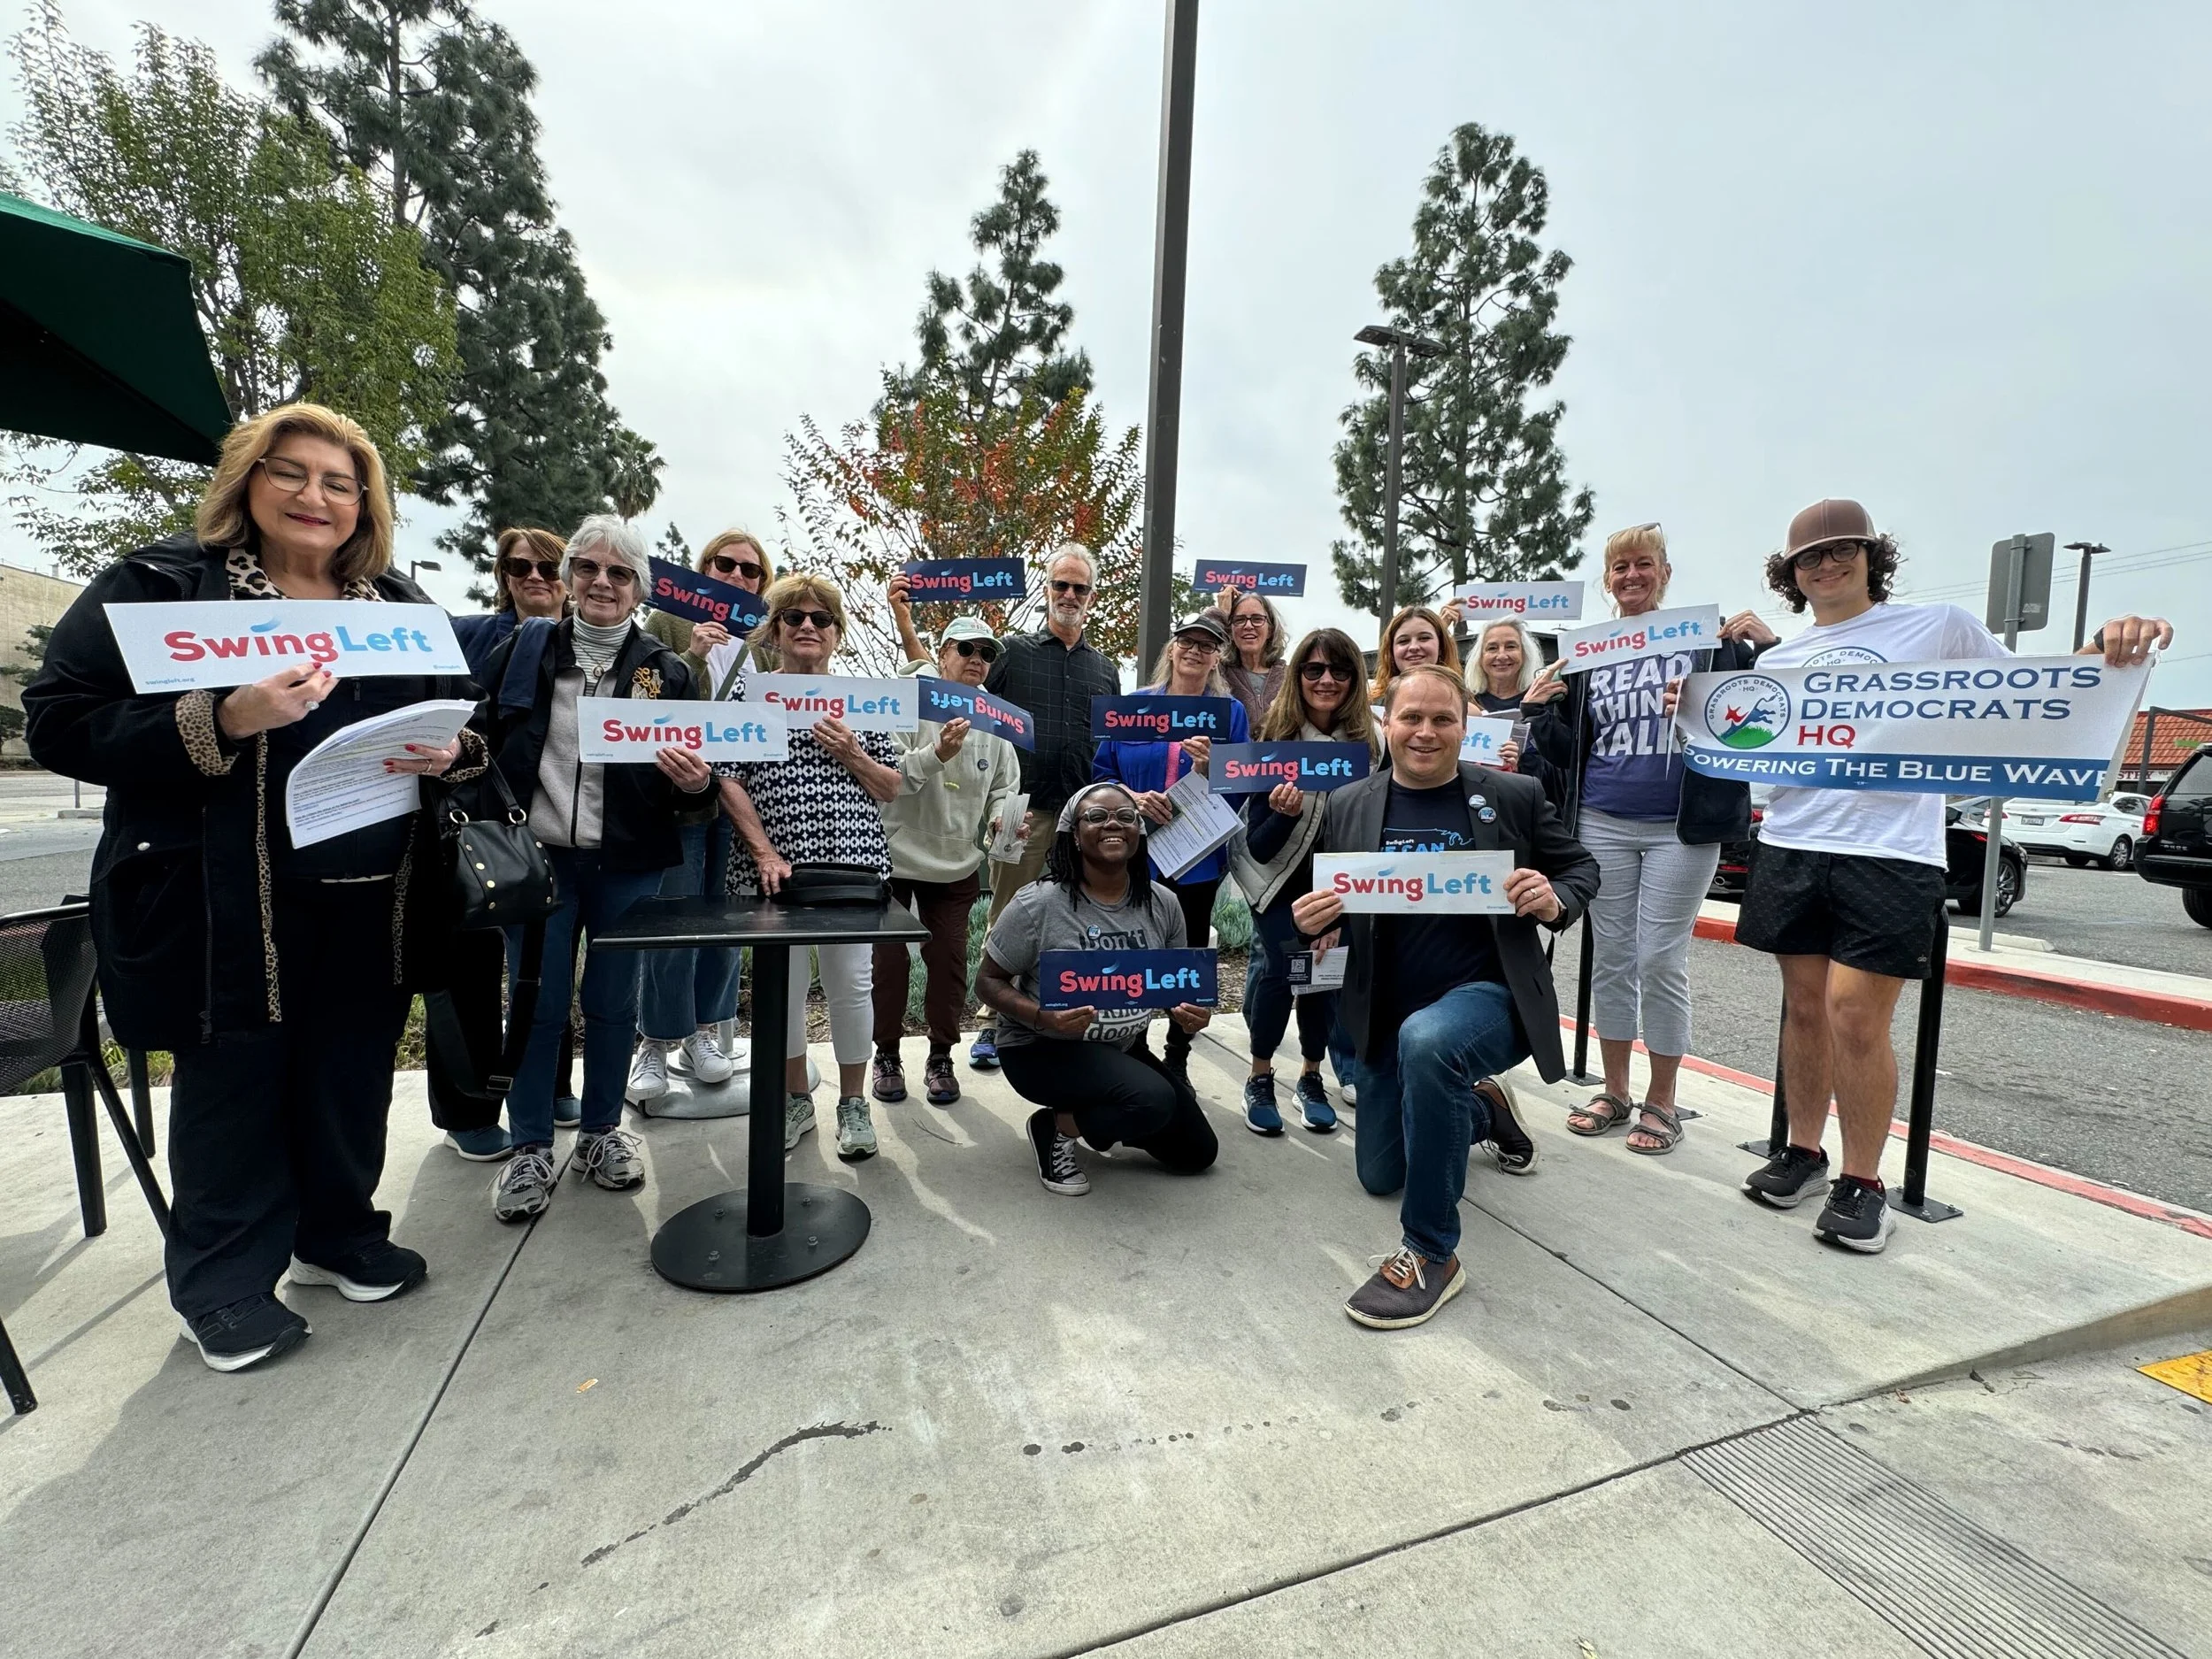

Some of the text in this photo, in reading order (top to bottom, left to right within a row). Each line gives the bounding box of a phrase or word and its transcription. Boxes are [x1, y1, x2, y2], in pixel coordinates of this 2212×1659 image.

[656, 577, 768, 626] SwingLe
[1590, 654, 1692, 699] READ
[1804, 666, 2102, 694] GRASSROOTS
[1592, 687, 1663, 725] THIN
[1709, 679, 1786, 719] GRASSROOTS DEMOCRATS
[1801, 699, 2072, 720] DEMOCRATS
[1797, 725, 1856, 749] HQ
[1825, 758, 1888, 779] THE
[1897, 761, 1992, 782] BLUE
